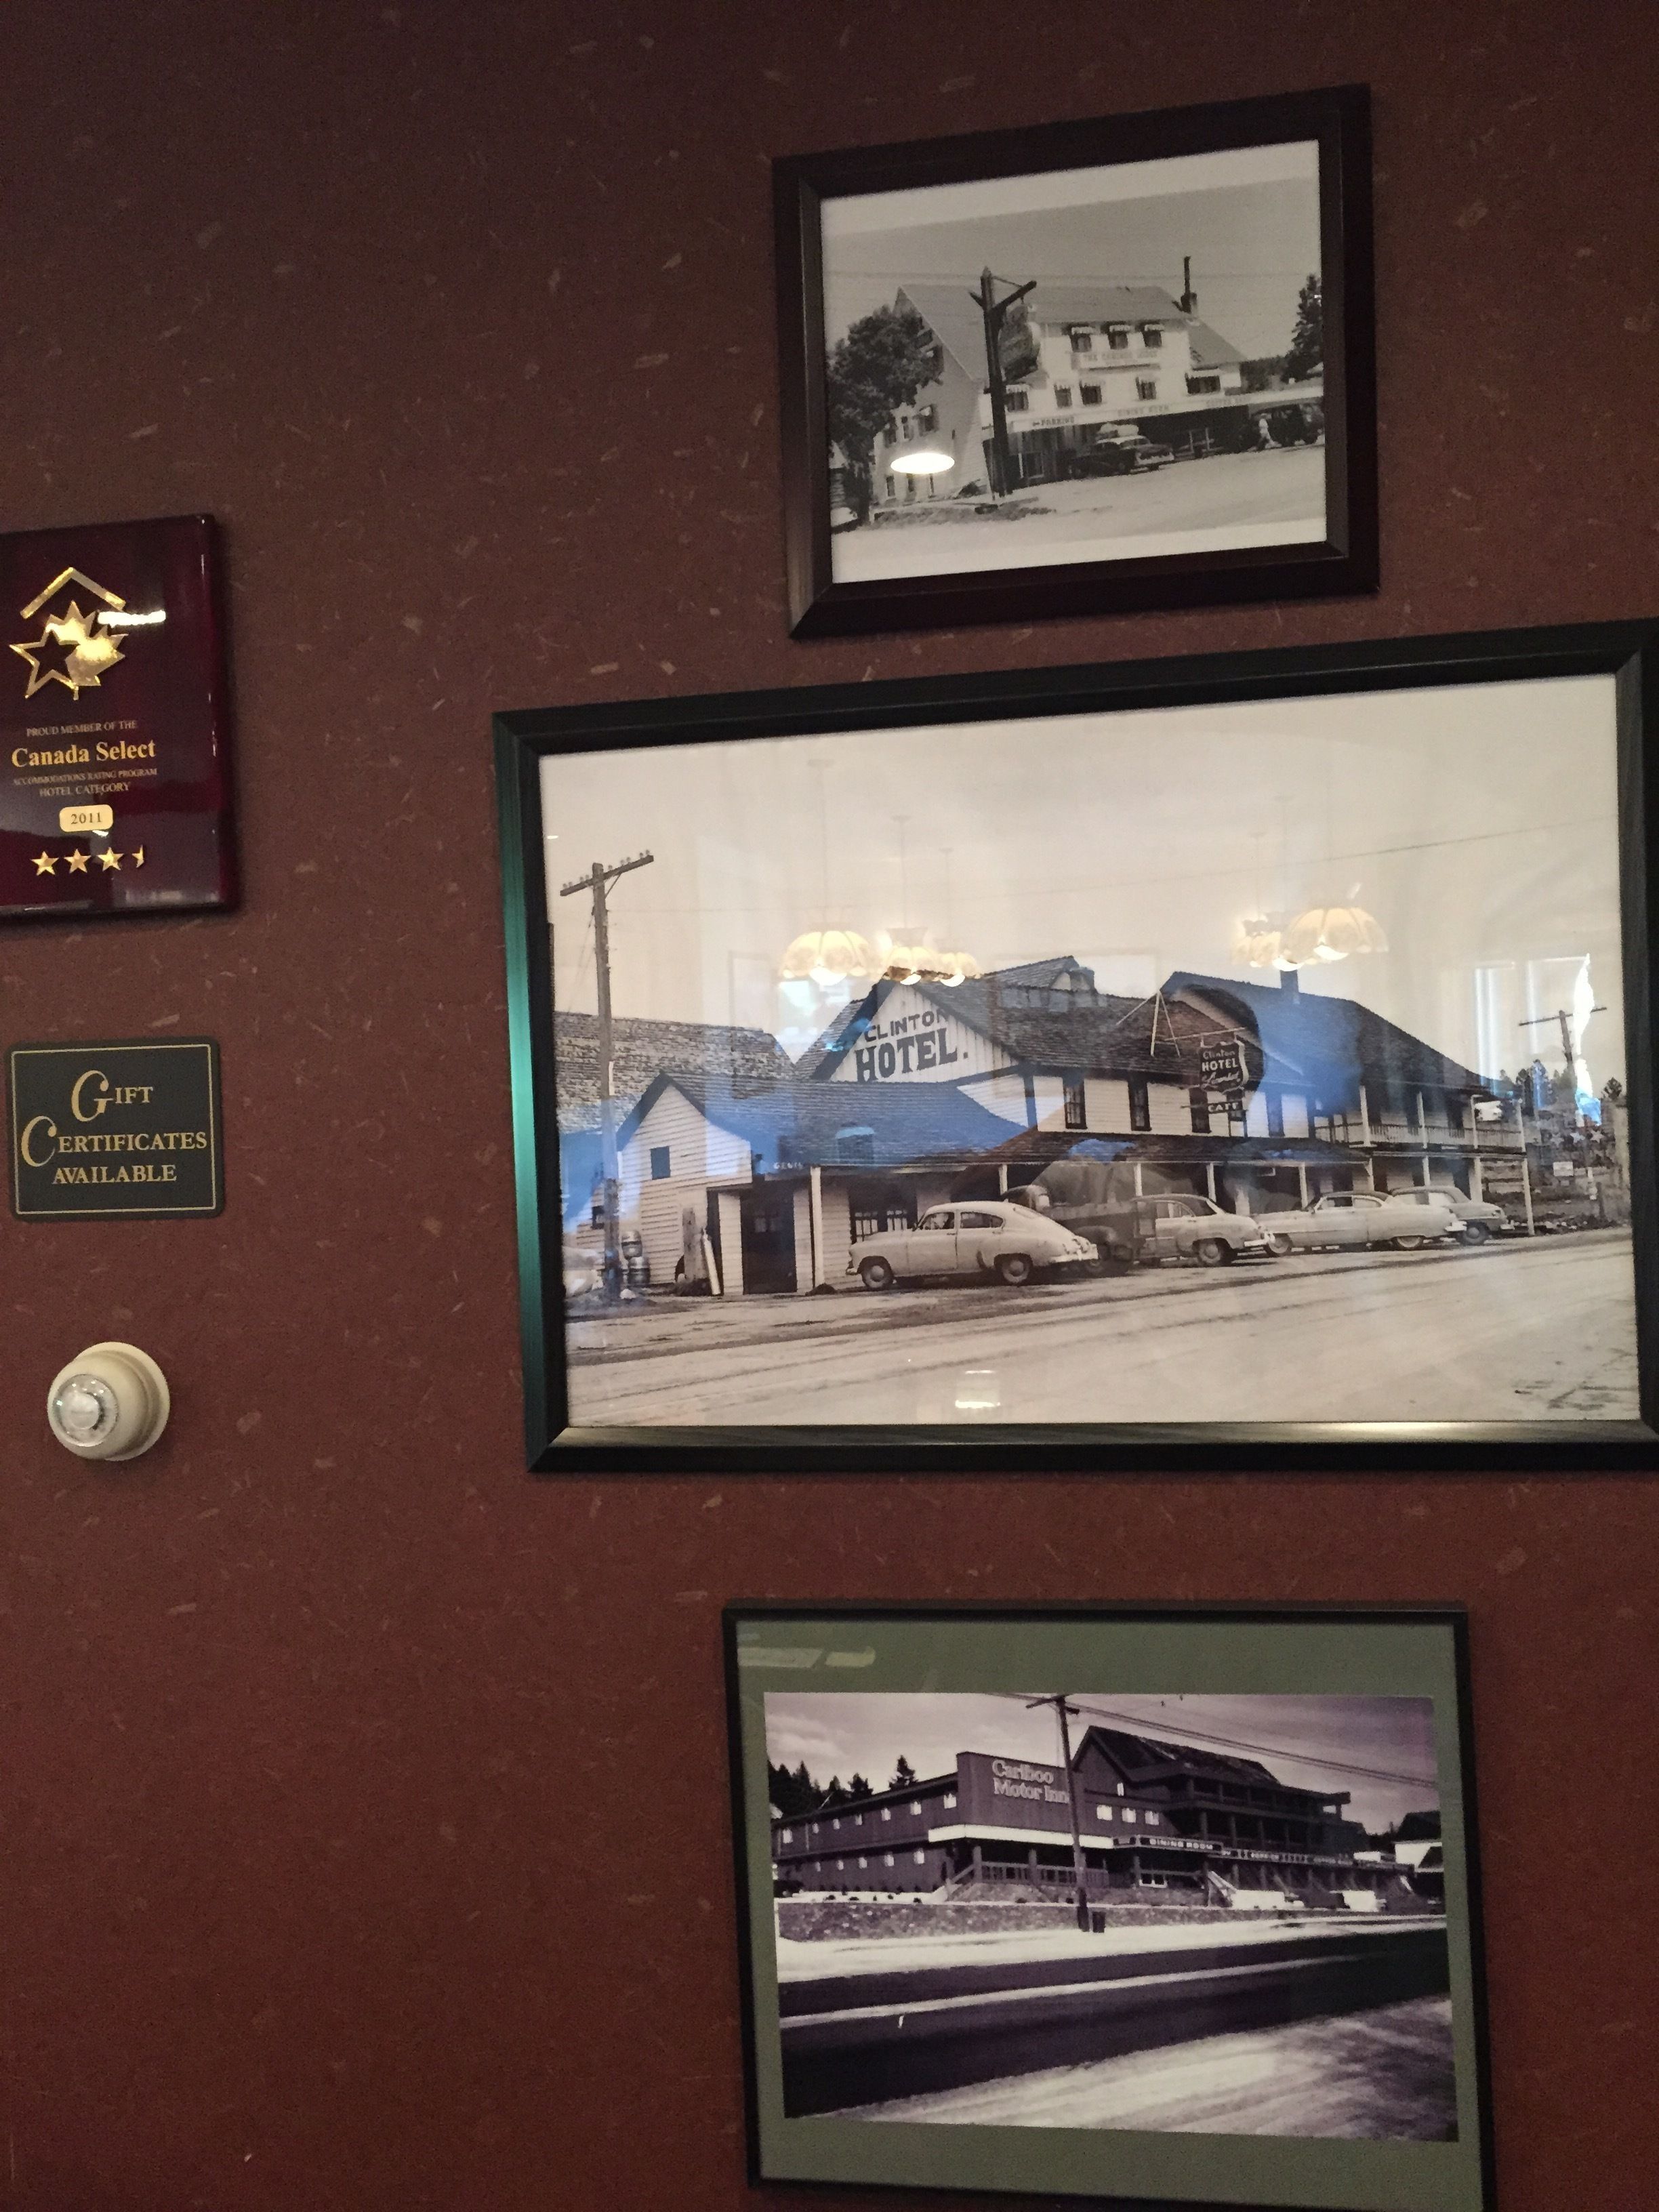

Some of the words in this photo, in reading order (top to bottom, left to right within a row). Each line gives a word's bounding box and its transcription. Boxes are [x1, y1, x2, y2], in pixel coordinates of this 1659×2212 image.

[26, 726, 59, 737] PROUD
[60, 722, 102, 735] MEMBER
[104, 721, 115, 731] OF
[119, 720, 138, 730] THE
[12, 744, 90, 768] Canada
[96, 739, 157, 762] Select
[118, 768, 157, 779] PROGRAM
[39, 786, 71, 797] HOTEL
[75, 782, 130, 795] CATEGORY
[70, 812, 102, 825] 2011
[1202, 1058, 1239, 1072] HOTEL
[71, 1069, 154, 1122] GIFT
[21, 1115, 207, 1167] CERTIFICATES
[52, 1164, 178, 1185] AVAILABLE
[991, 1759, 1054, 1784] Cariboo
[993, 1776, 1042, 1801] Motor
